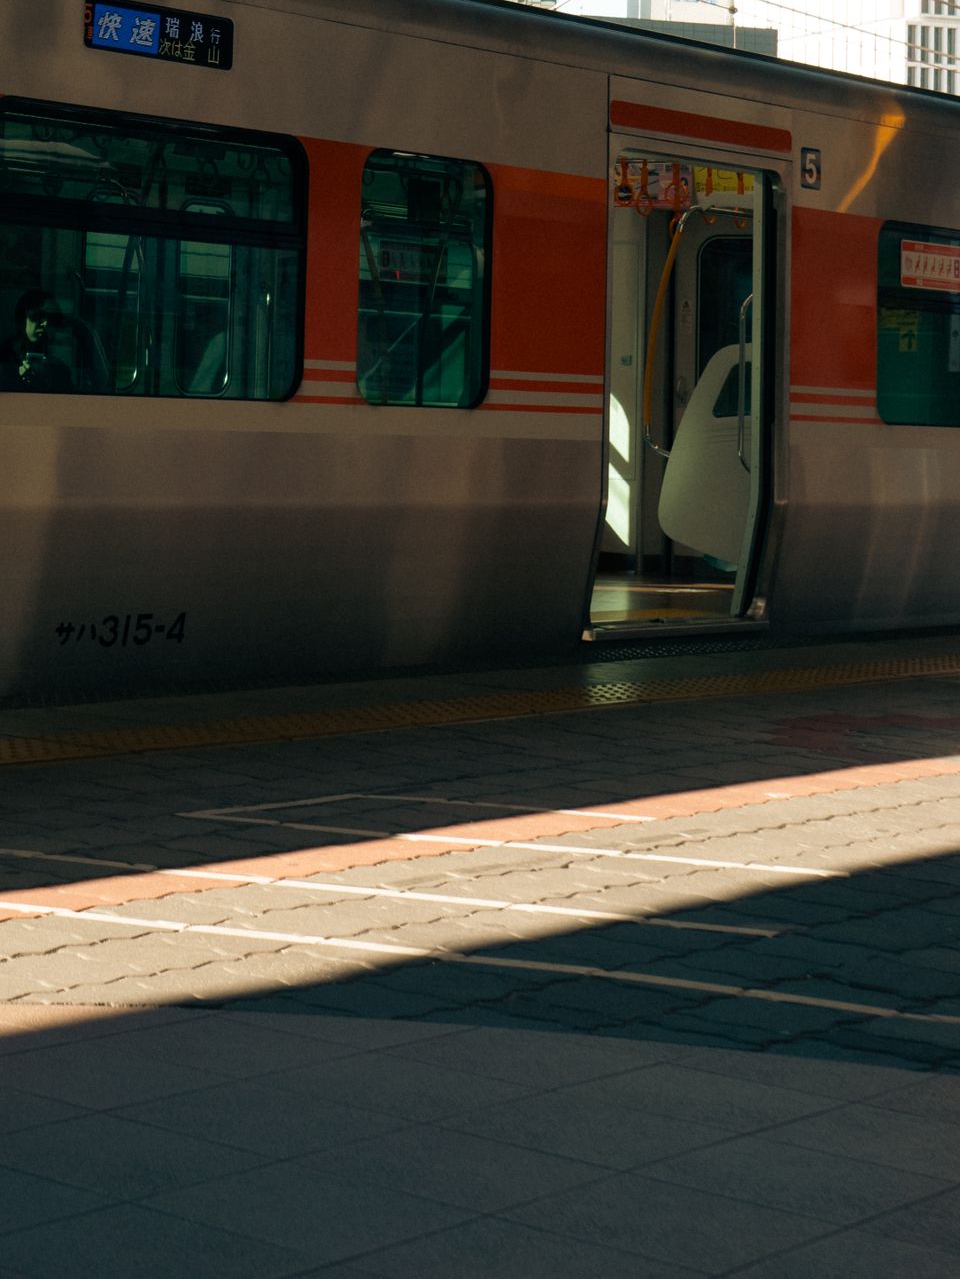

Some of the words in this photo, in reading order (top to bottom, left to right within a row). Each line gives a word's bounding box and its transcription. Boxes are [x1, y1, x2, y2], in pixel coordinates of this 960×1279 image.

[98, 12, 156, 47] 快速
[805, 154, 818, 184] 5
[55, 611, 187, 647] サハ315-4
